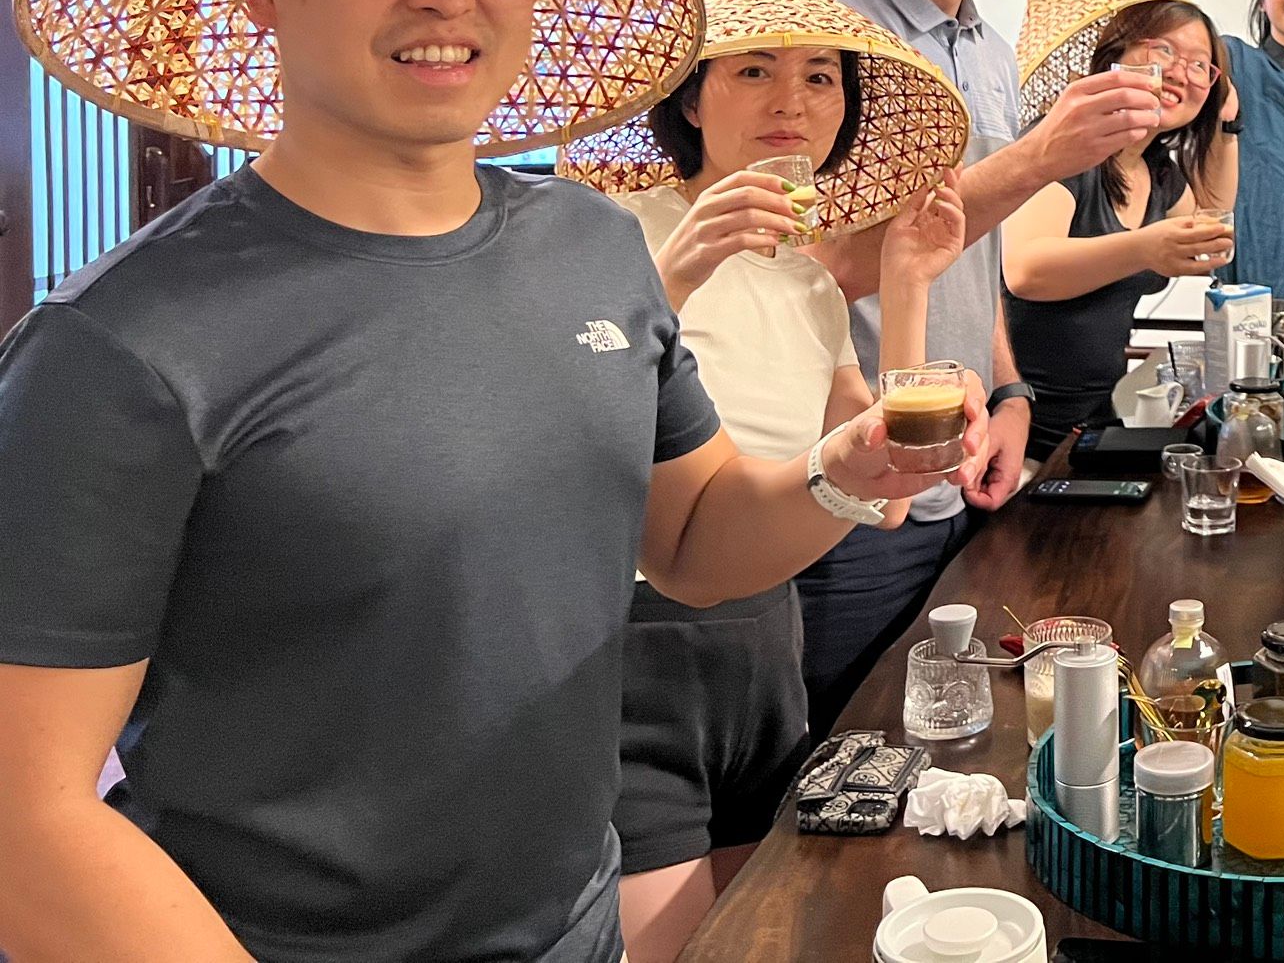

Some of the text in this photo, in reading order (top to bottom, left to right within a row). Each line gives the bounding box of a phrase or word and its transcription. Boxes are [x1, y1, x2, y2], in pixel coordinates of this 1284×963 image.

[585, 321, 606, 332] THE
[576, 330, 611, 345] NORTH
[590, 340, 616, 354] FACE
